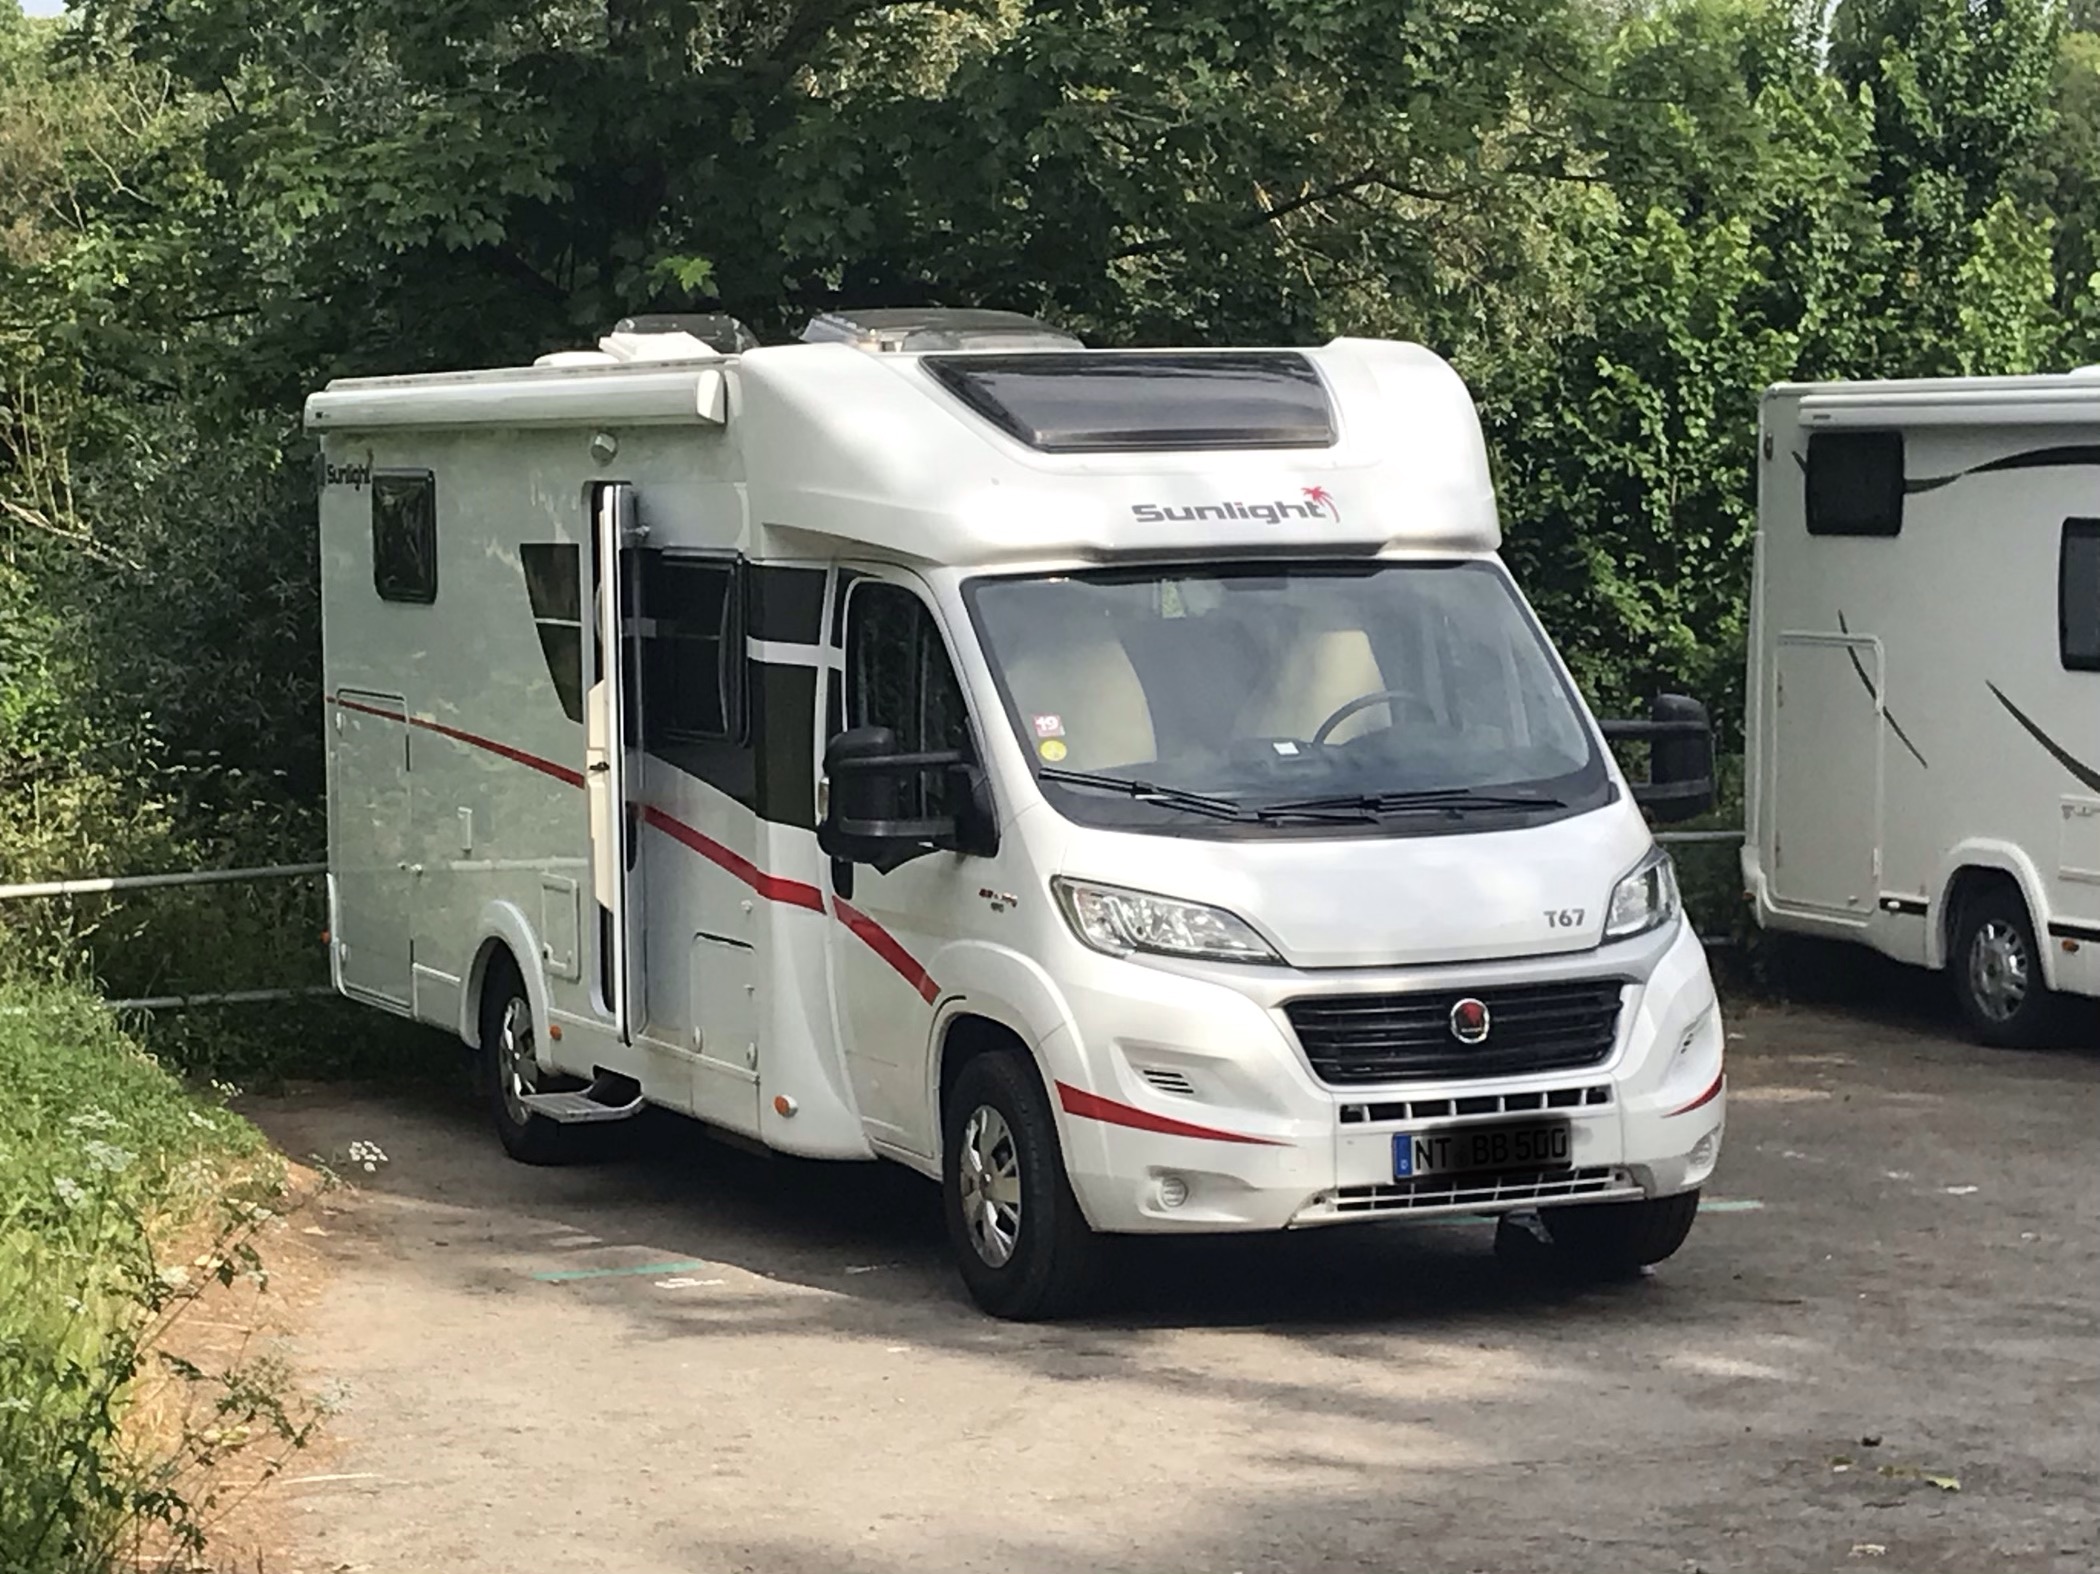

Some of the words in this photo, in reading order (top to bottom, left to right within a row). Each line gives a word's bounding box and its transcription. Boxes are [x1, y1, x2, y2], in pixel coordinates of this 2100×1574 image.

[327, 464, 370, 491] Sunlight
[1132, 501, 1326, 525] Sunlight
[1035, 715, 1058, 731] 19
[1544, 908, 1585, 928] T67
[1415, 1138, 1451, 1170] NT
[1472, 1133, 1509, 1164] BB
[1516, 1128, 1567, 1161] 500
